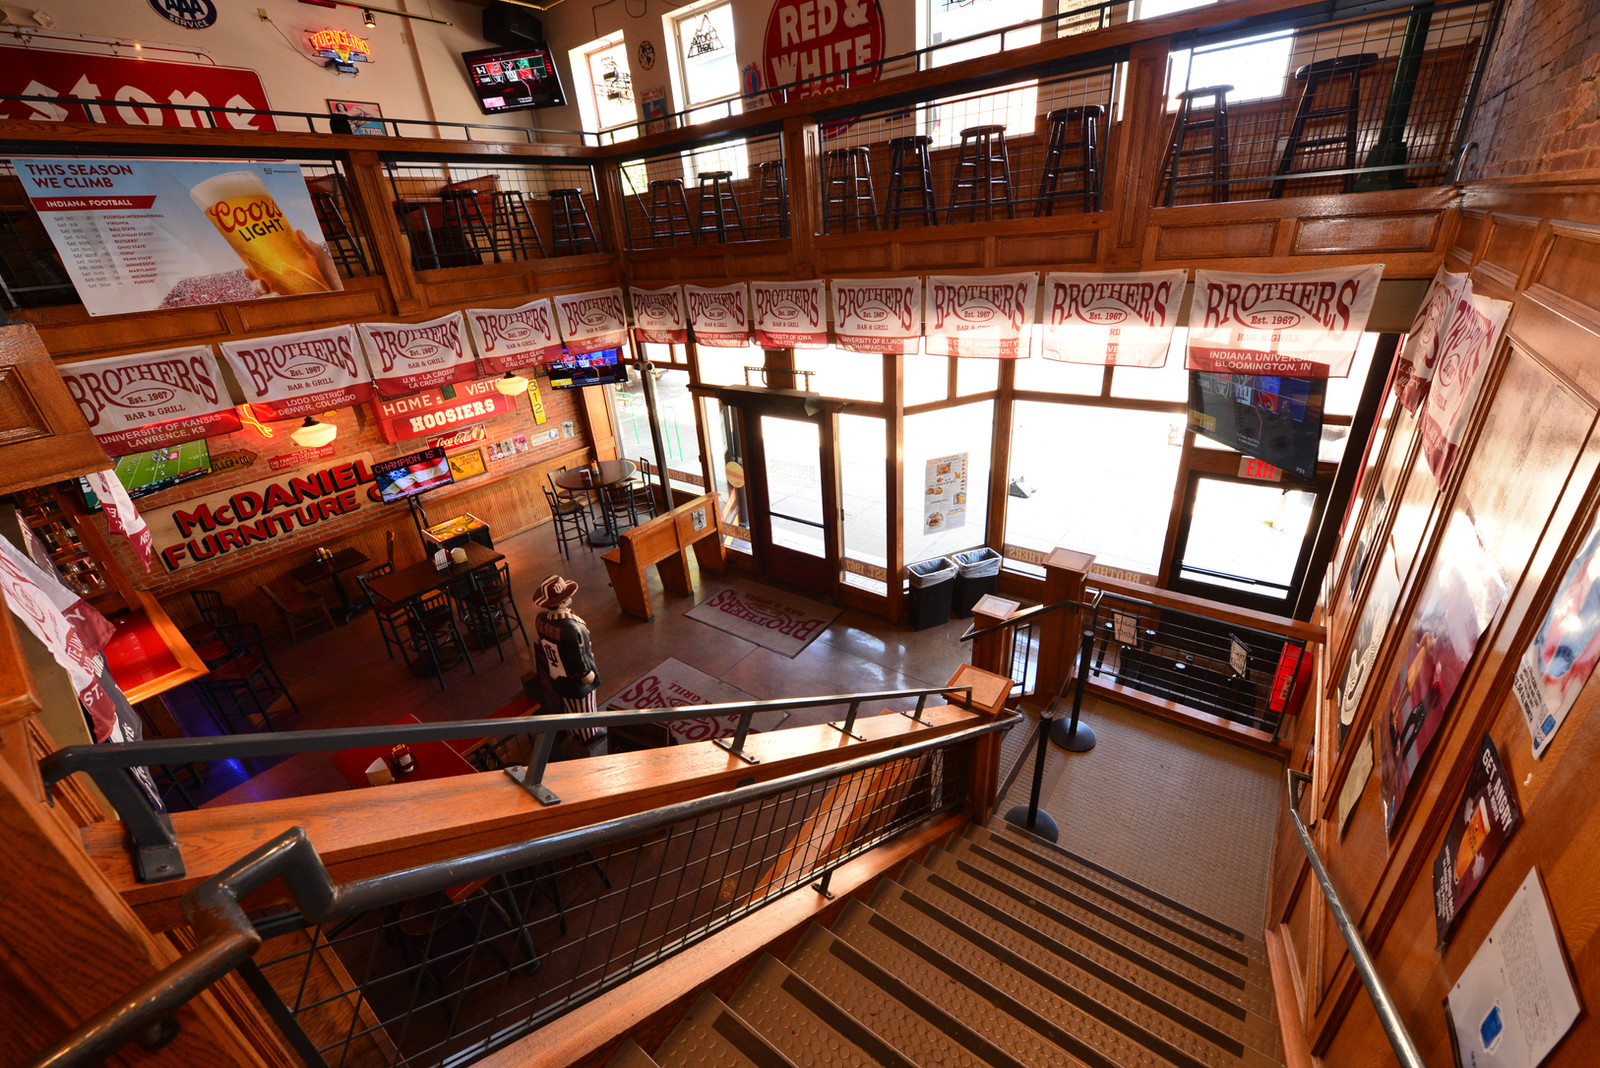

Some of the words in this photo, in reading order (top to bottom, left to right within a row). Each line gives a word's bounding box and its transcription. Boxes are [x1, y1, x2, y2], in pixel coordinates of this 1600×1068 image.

[169, 14, 209, 28] SERVICE
[779, 0, 838, 48] RED
[311, 29, 371, 56] YUENGLING
[771, 33, 872, 93] WHITE
[0, 74, 260, 131] stone
[25, 164, 66, 177] THIS
[69, 163, 134, 176] SEASON
[32, 178, 52, 189] WE
[54, 177, 114, 189] CLIMB
[46, 200, 86, 208] INDIANA
[88, 199, 133, 207] FOOTBALL
[210, 200, 283, 233] Coors
[239, 219, 285, 243] LIGHT
[561, 295, 625, 336] BROTHERS
[633, 292, 680, 325] BROTHERS
[689, 291, 745, 327] BROTHERS
[756, 288, 819, 328] BROTHERS
[838, 287, 914, 331] BROTHERS
[934, 283, 1028, 332] BROTHERS
[1052, 281, 1172, 327] BROTHERS
[1089, 312, 1103, 320] Est.
[1204, 279, 1360, 338] BROTHERS
[476, 306, 551, 352] BROTHERS
[1251, 316, 1268, 324] Est.
[1271, 316, 1294, 324] 1967
[369, 320, 463, 373] BROTHERS
[527, 349, 545, 358] CLAIRE
[1209, 350, 1252, 361] INDIANA
[1255, 351, 1321, 362] UNIVERSITY
[237, 335, 358, 397] BROTHERS
[289, 369, 304, 377] Est.
[306, 366, 321, 374] 1967
[427, 357, 445, 366] GRILL
[434, 368, 456, 377] CROSSE
[519, 357, 537, 365] CLAIRE
[1215, 360, 1297, 372] BLOOMINGTON,
[1300, 362, 1312, 371] IN
[62, 356, 219, 428] BROTHERS
[312, 378, 334, 387] GRILL
[420, 377, 446, 387] CROSSE
[127, 395, 146, 405] Est.
[148, 392, 168, 401] 1967
[278, 404, 314, 416] DENVER,
[315, 394, 356, 408] COLORADO
[286, 397, 310, 407] LODO
[311, 390, 347, 401] DISTRICT
[384, 395, 432, 416] HOME
[125, 412, 146, 421] BAR
[158, 405, 186, 414] GRILL
[409, 398, 496, 433] HOOSIERS
[100, 424, 163, 444] UNIVERSITY
[166, 422, 179, 431] OF
[182, 414, 221, 427] KANSAS
[127, 429, 191, 448] LAWRENCE,
[192, 425, 206, 434] KS
[374, 455, 421, 474] CHAMPION
[425, 450, 434, 459] IS
[172, 459, 375, 538] McDANIEL
[161, 490, 361, 571] FURNITURE
[706, 589, 826, 641] BROTHERS
[1482, 748, 1497, 781] GET
[1493, 776, 1513, 833] ANGRY
